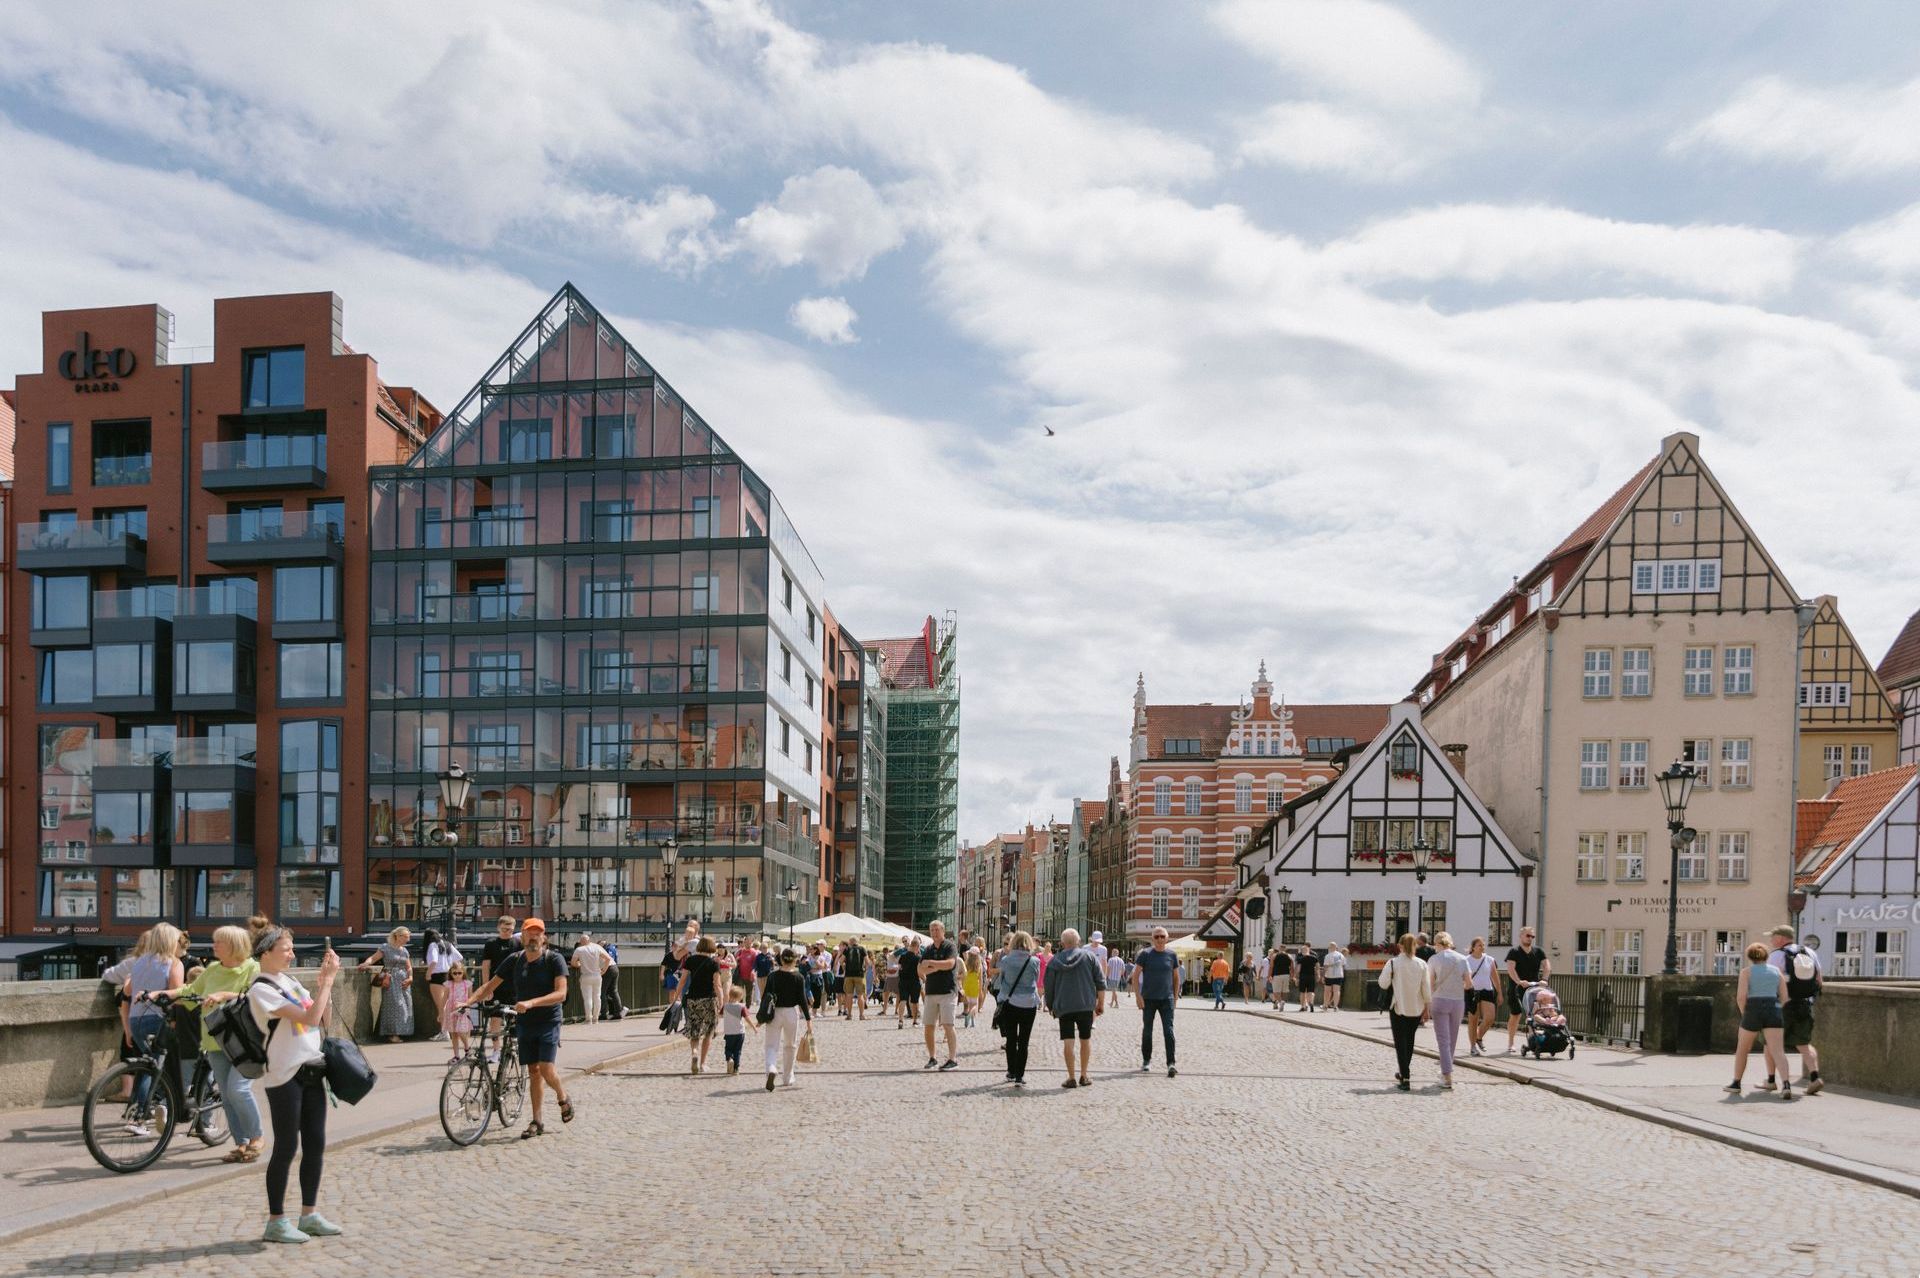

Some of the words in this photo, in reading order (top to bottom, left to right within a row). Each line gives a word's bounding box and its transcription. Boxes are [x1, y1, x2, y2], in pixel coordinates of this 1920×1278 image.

[58, 331, 137, 381] deo
[75, 382, 120, 393] PLAZA
[1630, 897, 1694, 905] DELMOCO
[1696, 897, 1717, 905] CUT
